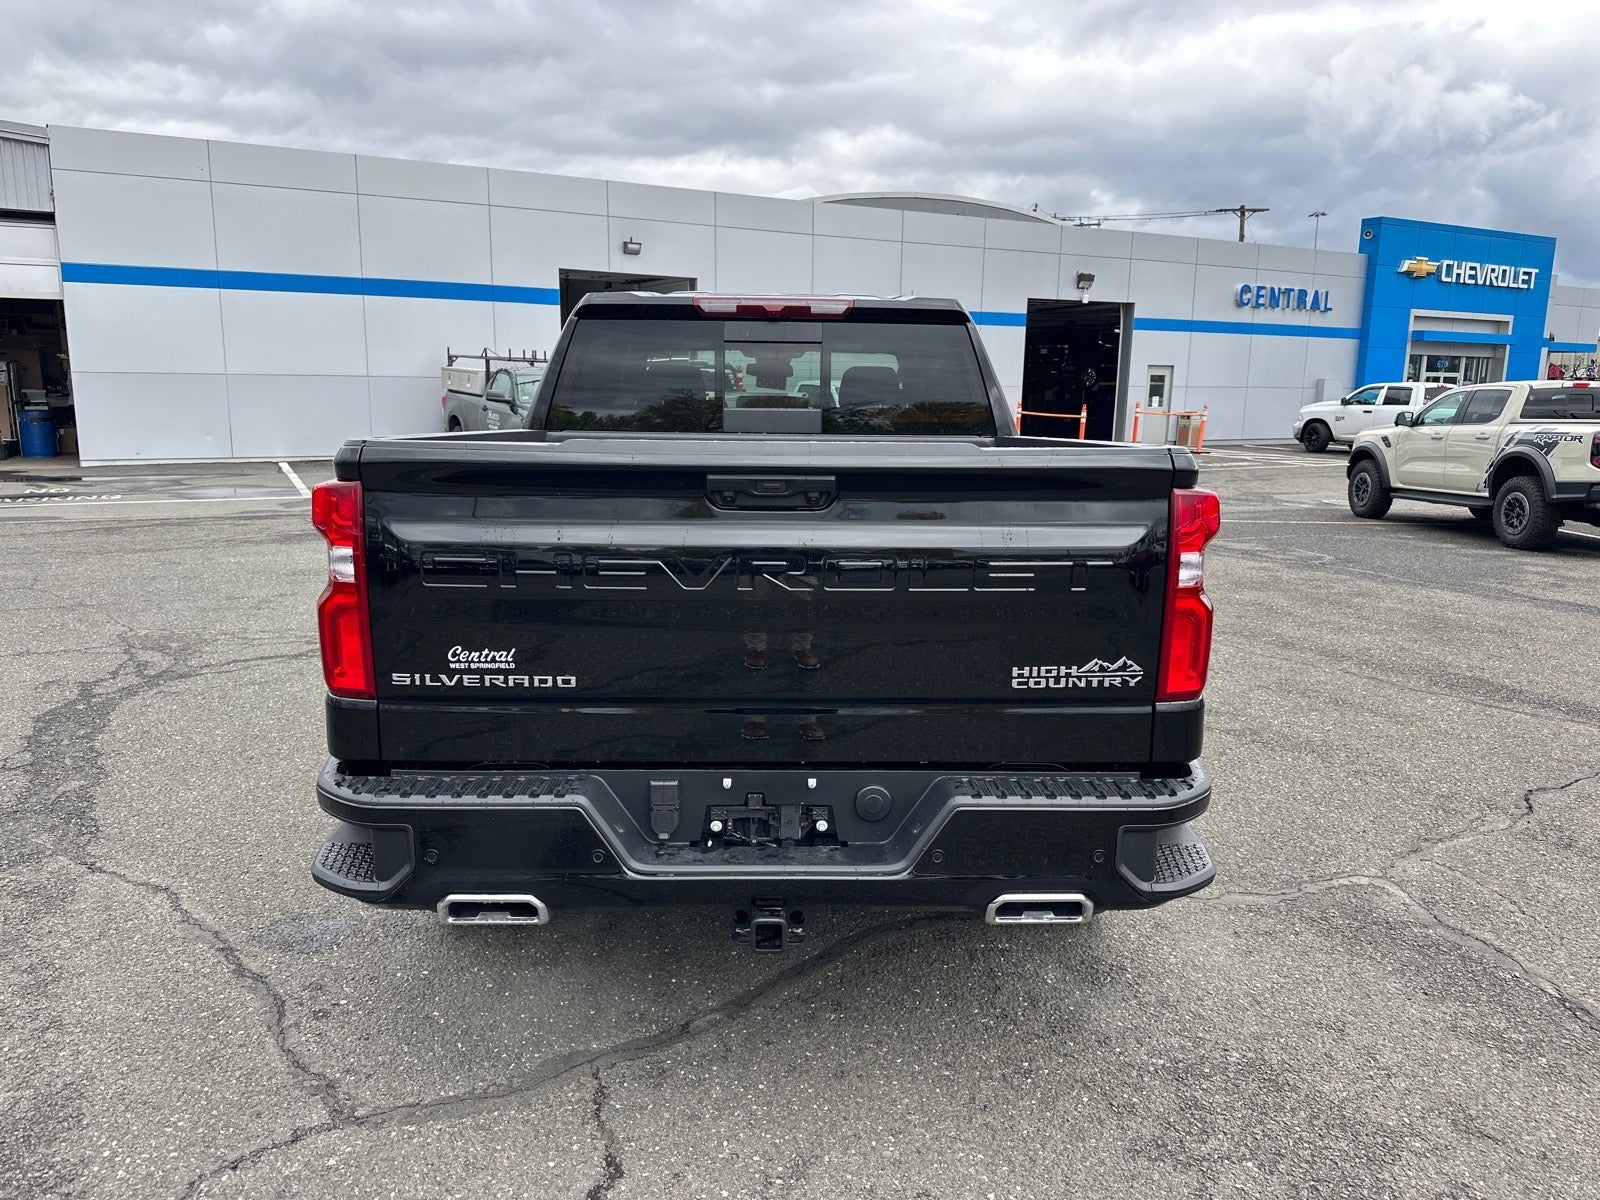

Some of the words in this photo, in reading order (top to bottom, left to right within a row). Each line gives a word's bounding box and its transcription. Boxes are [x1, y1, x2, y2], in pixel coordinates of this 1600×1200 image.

[1440, 259, 1539, 290] CHEVROLET
[1237, 283, 1333, 313] CENTRAL
[1533, 433, 1584, 446] RAPTOR
[0, 494, 122, 502] ARKING
[421, 552, 1115, 593] CHEVROLET
[447, 645, 516, 662] Central
[1011, 665, 1078, 678] HIGH
[391, 672, 577, 688] SILVERADO
[1011, 676, 1143, 689] COUNTRY
